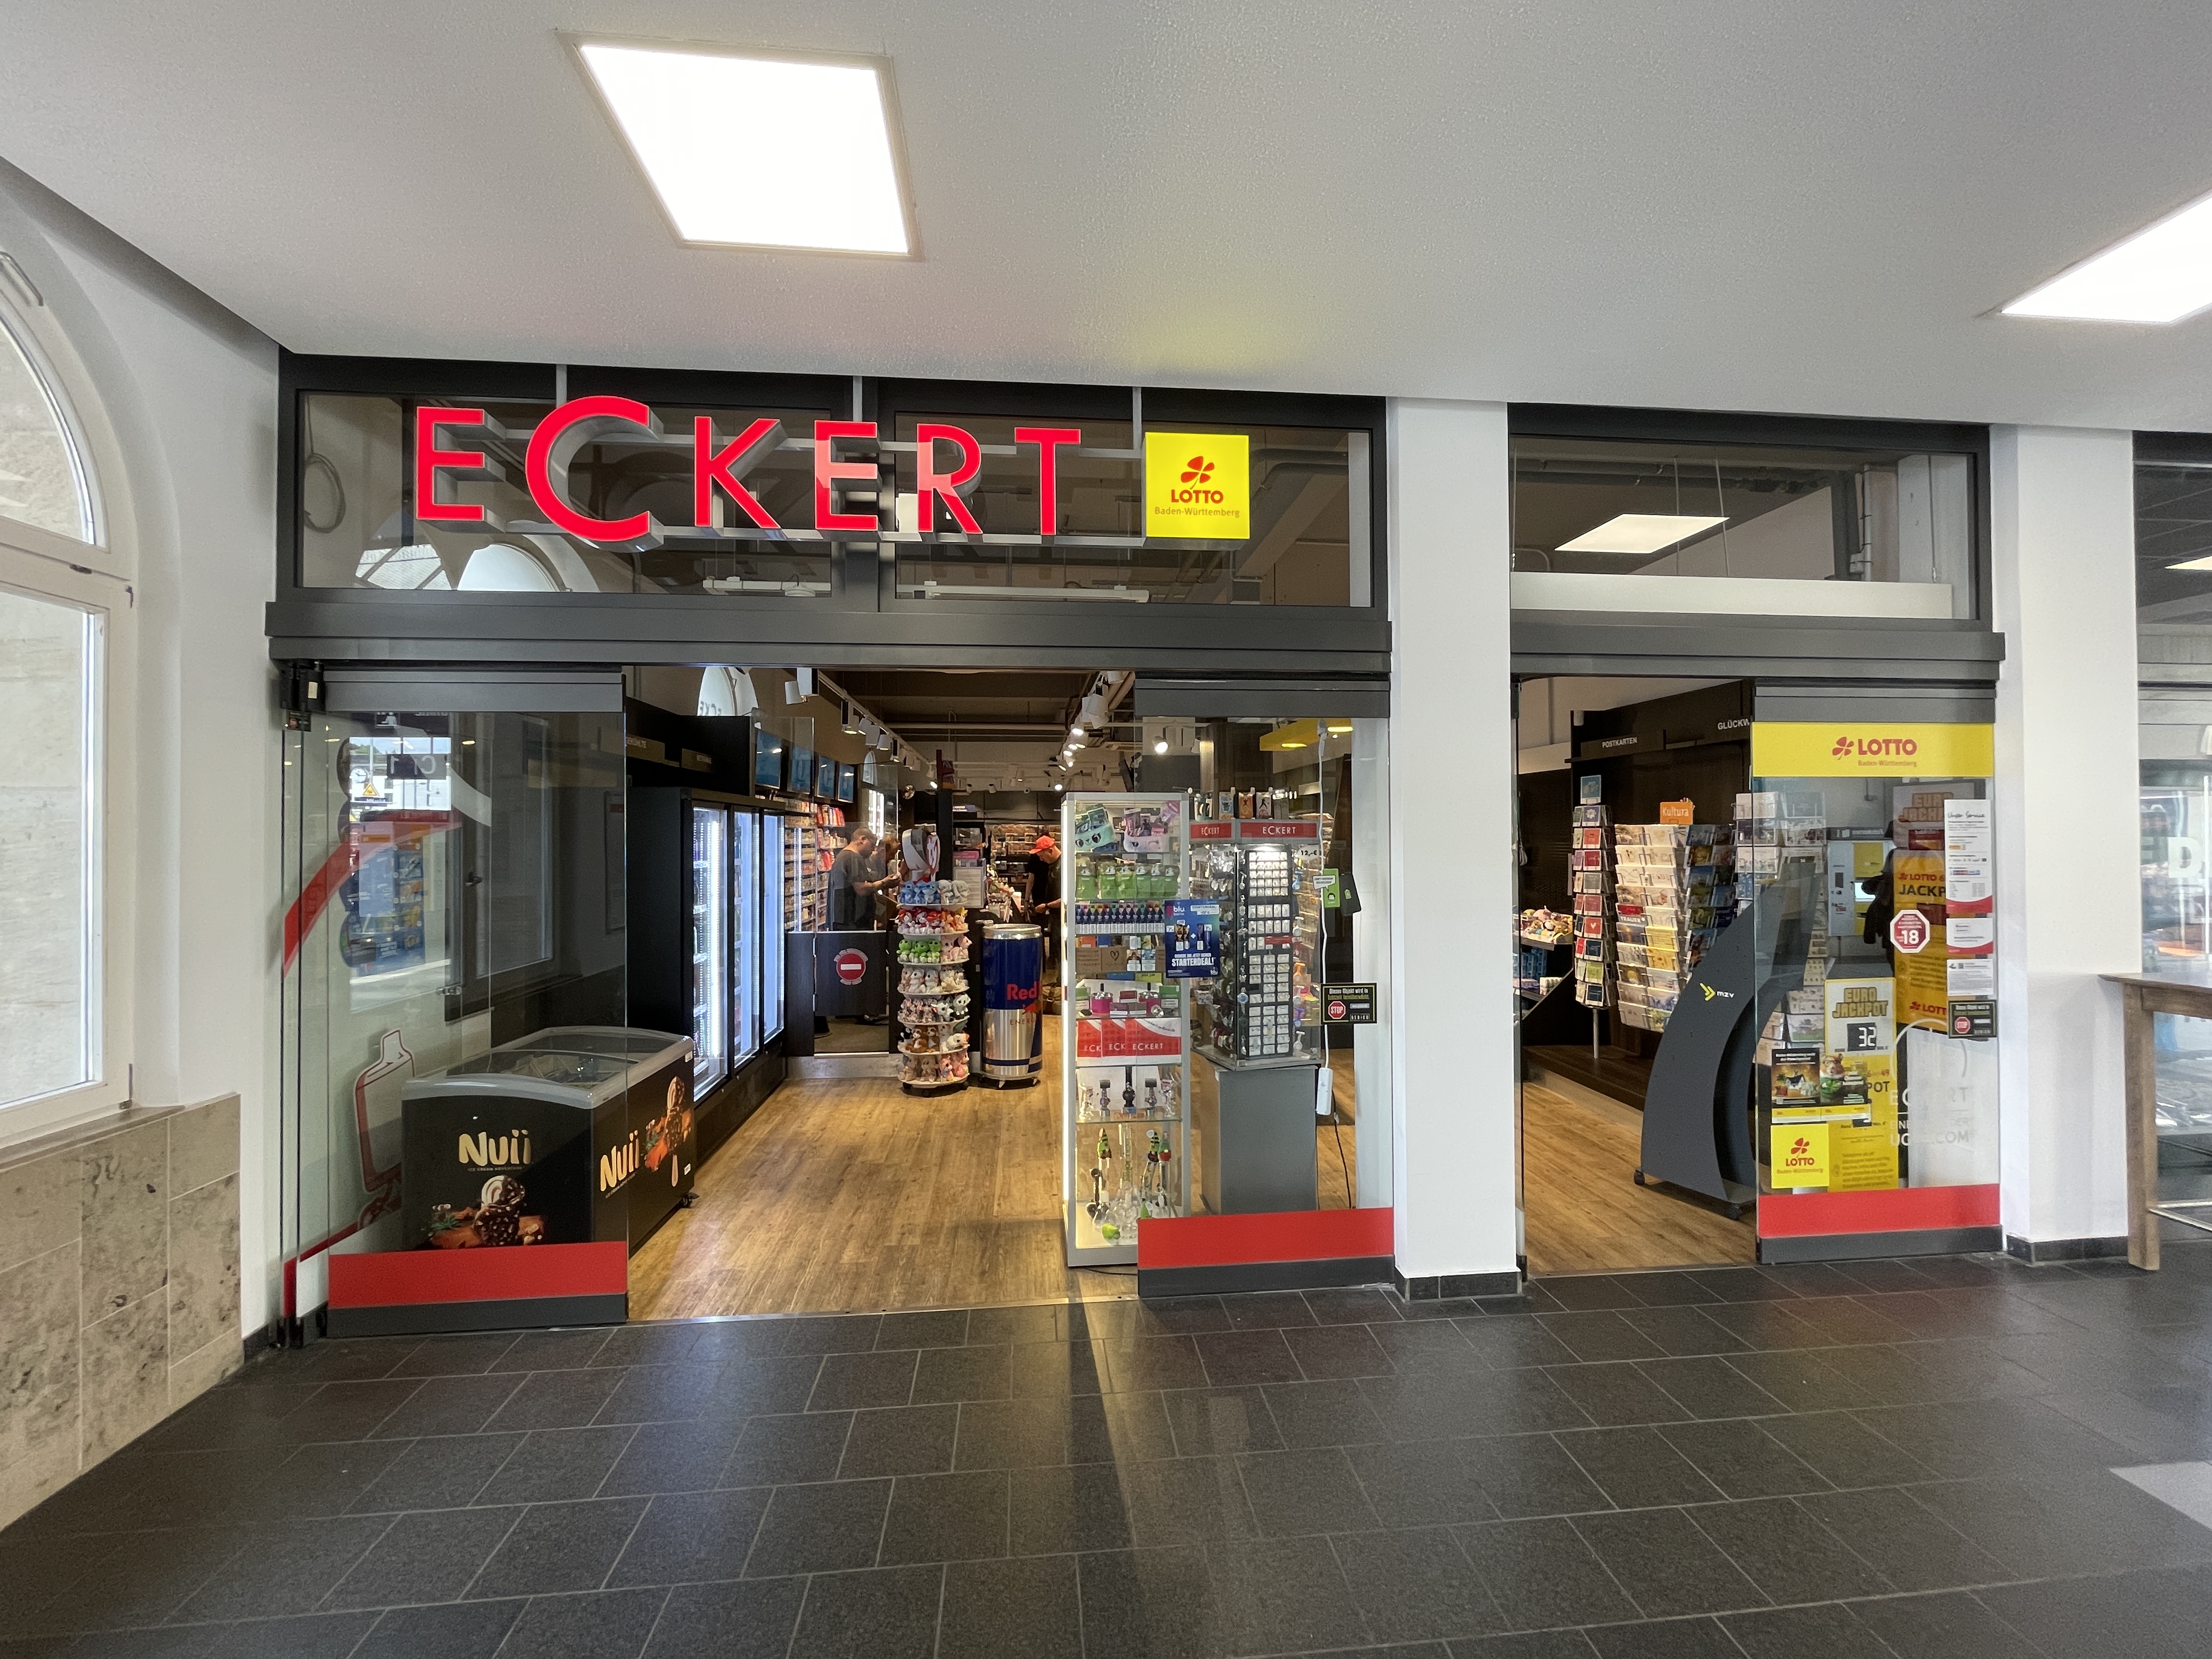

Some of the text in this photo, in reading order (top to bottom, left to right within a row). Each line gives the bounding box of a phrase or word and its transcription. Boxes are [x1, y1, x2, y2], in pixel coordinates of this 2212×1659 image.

[416, 395, 1081, 541] ECKERT
[1171, 489, 1224, 504] LOTTO
[1154, 506, 1240, 518] Baden-Württemberg
[1602, 736, 1638, 748] POSTKARTEN
[1858, 738, 1917, 755] LOTTO
[1662, 805, 1689, 816] Kultura
[1201, 827, 1220, 836] ECKERT
[1262, 826, 1296, 835] ECKERT
[1899, 884, 1945, 898] JACKP
[1901, 929, 1920, 945] 18
[1007, 980, 1037, 1001] Red
[1843, 986, 1877, 1002] EURO
[1330, 1006, 1344, 1014] STOP
[1832, 1000, 1888, 1019] JACKPOT
[1922, 1003, 1947, 1015] LOTT
[1858, 1026, 1876, 1047] 32
[1084, 1044, 1101, 1052] ECK
[1109, 1042, 1125, 1051] ECK
[1132, 1042, 1164, 1051] ECKERT
[459, 1128, 531, 1166] Nuii
[600, 1130, 640, 1192] Nuii
[1786, 1157, 1815, 1166] LOTTO
